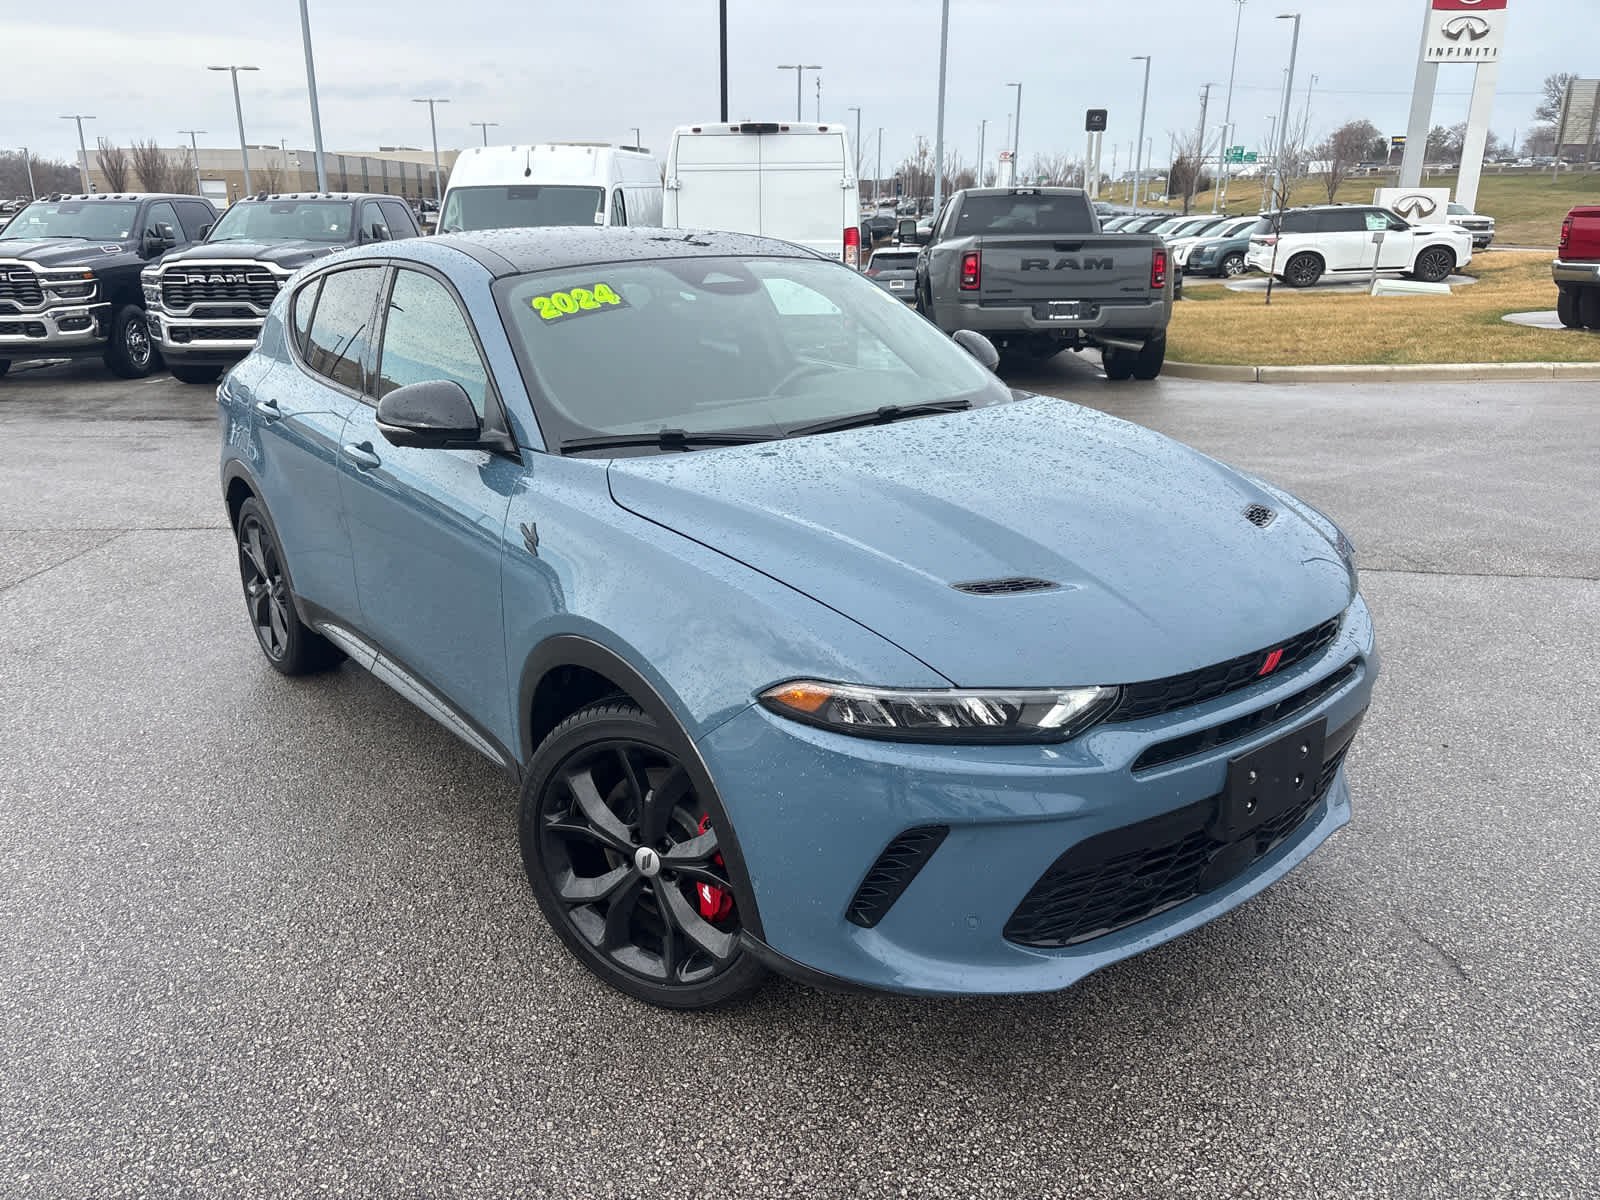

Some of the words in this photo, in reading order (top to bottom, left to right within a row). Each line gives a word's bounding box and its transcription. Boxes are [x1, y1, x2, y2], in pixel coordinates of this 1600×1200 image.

[1428, 47, 1497, 57] INFINITI
[1021, 257, 1113, 271] RAM
[188, 273, 246, 284] RAM
[532, 283, 621, 319] 2024
